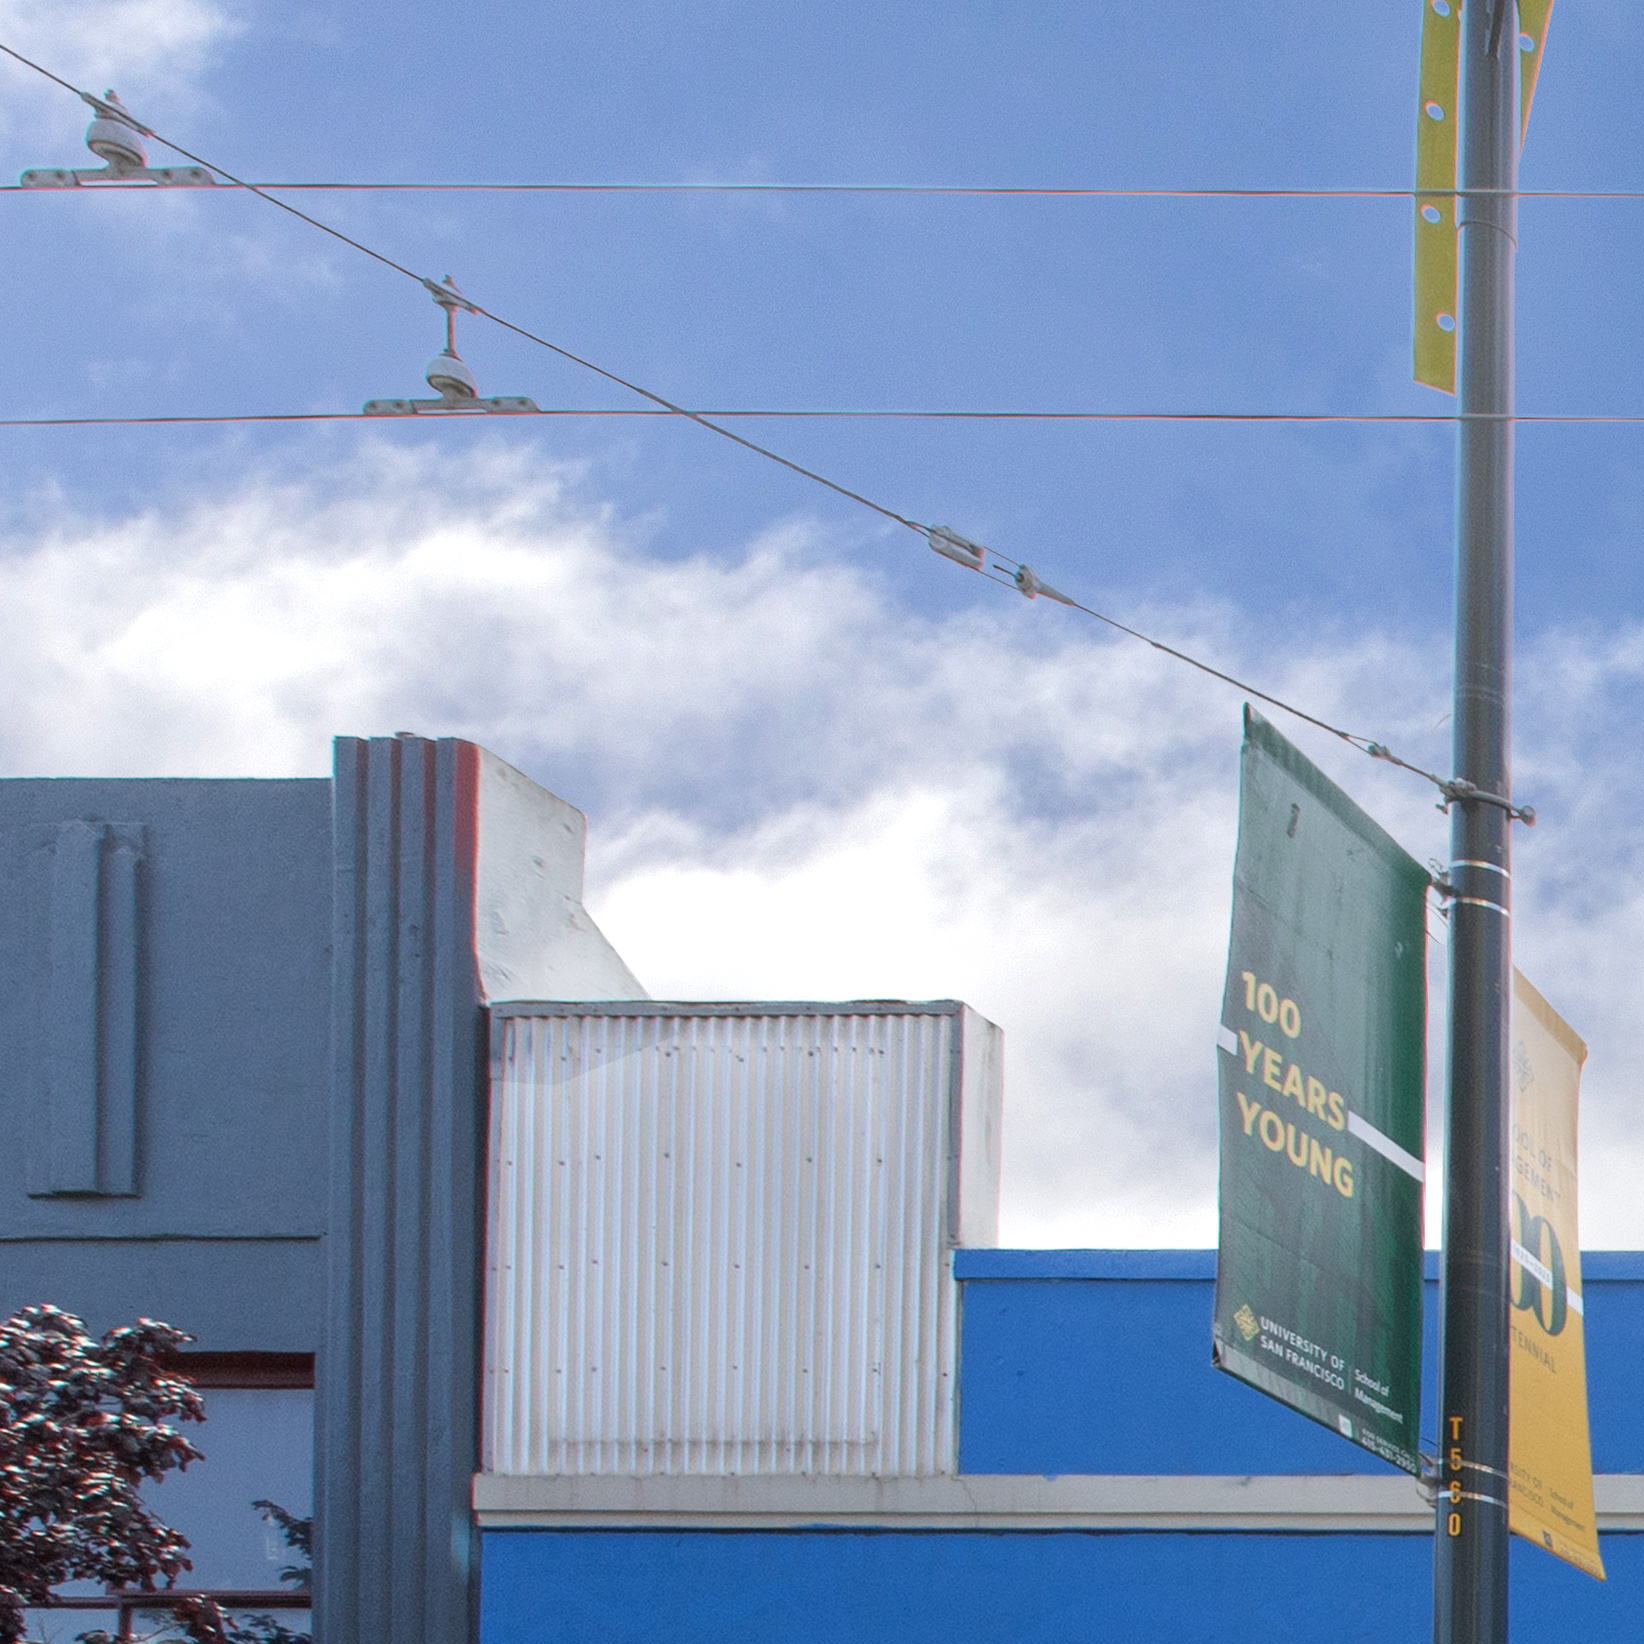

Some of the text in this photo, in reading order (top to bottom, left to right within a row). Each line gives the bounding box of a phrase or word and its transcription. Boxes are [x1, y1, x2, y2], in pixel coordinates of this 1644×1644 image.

[1241, 971, 1301, 1039] 100
[1239, 1030, 1345, 1132] YEARS
[1236, 1091, 1354, 1198] YOUNG
[1509, 1188, 1568, 1336] 00
[1260, 1316, 1345, 1372] UNIVERSITY OF
[1260, 1335, 1345, 1391] SAN FRANCISCO
[1354, 1369, 1381, 1393] School
[1354, 1387, 1404, 1424] Management
